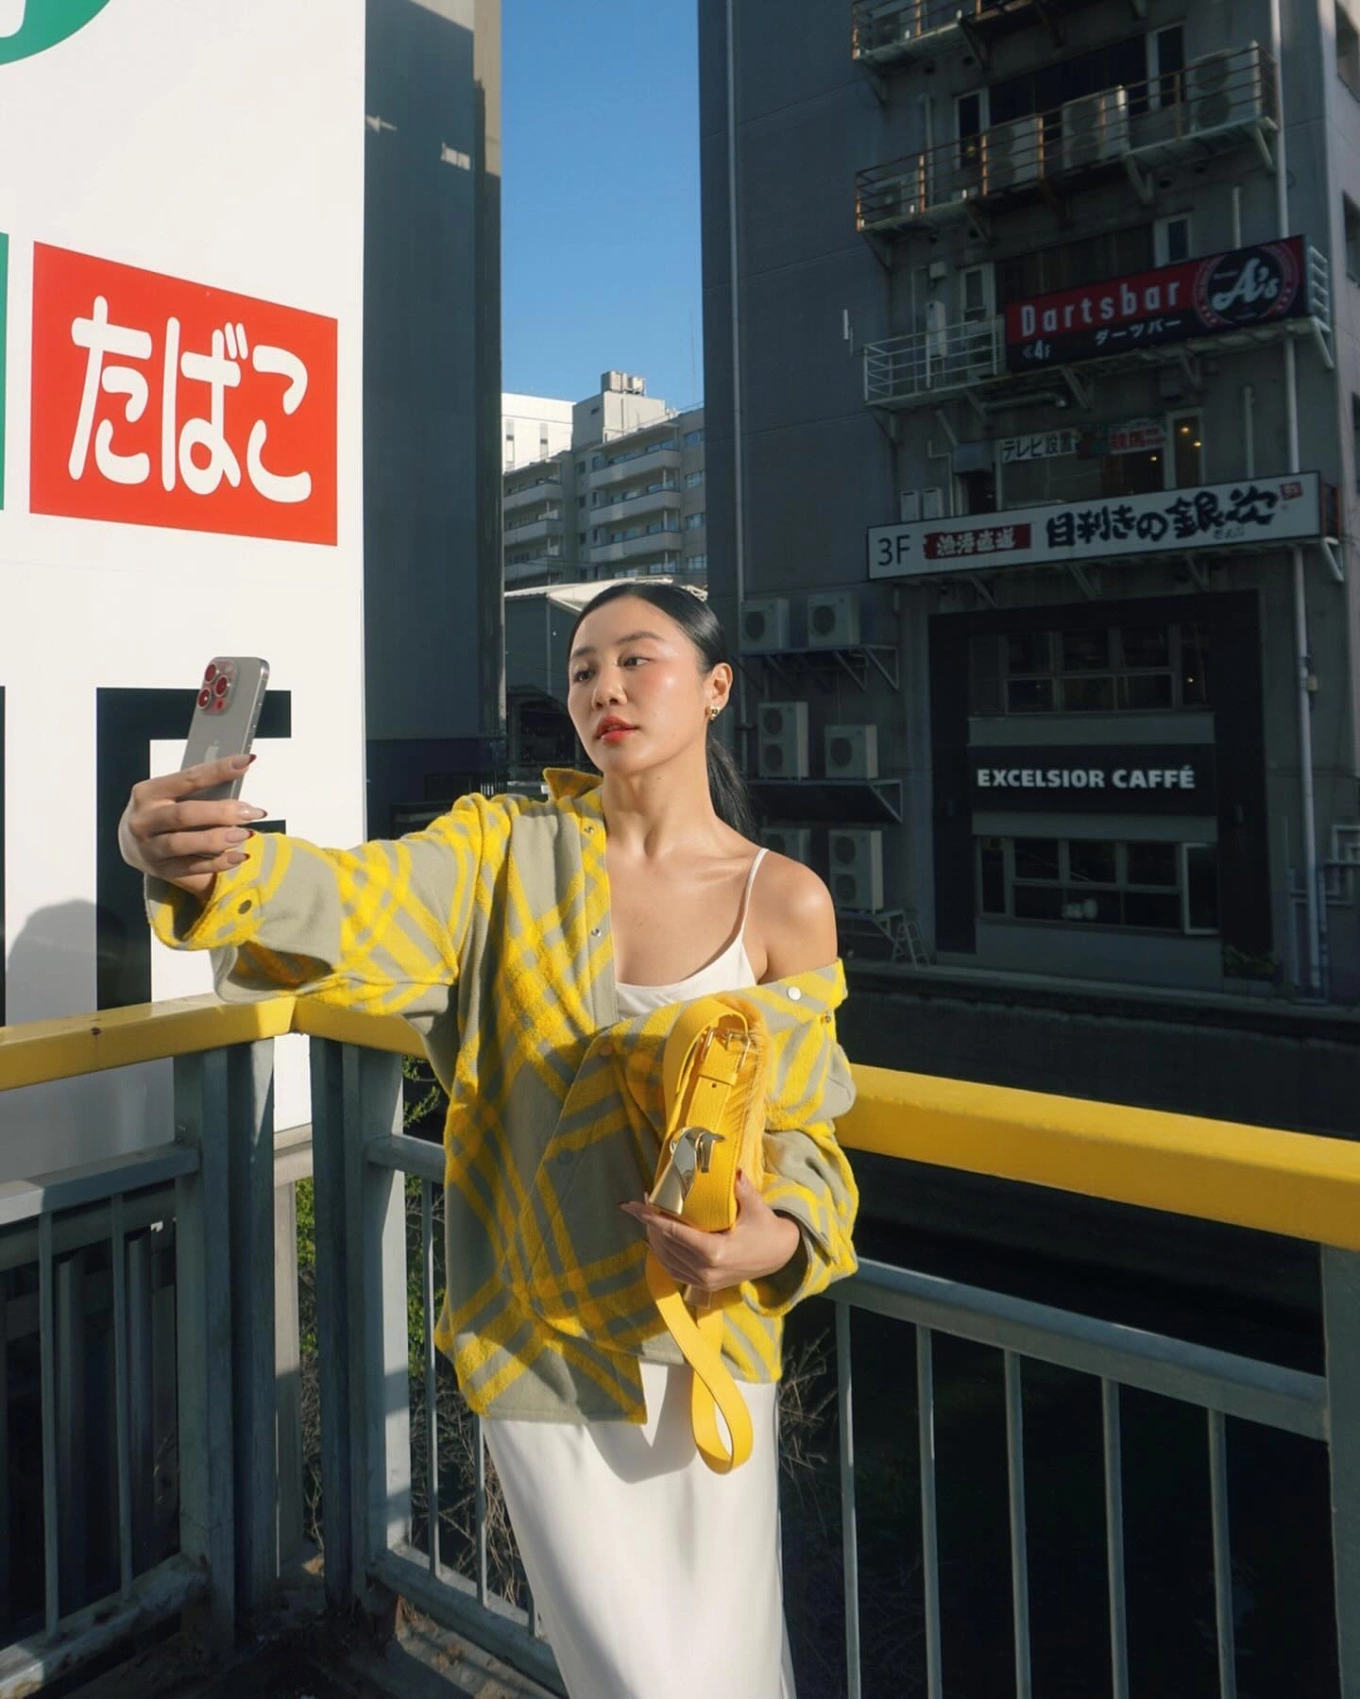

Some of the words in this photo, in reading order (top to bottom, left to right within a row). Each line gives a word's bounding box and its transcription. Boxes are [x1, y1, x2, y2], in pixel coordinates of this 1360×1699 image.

[1020, 281, 1181, 337] Dartsbar
[1094, 317, 1182, 347] ダーツバー
[68, 295, 311, 503] たばこ
[1046, 485, 1278, 547] 目利きの銀次
[878, 535, 911, 566] 3F
[976, 768, 1106, 788] EXCELSIOR
[1111, 765, 1196, 789] CAFFÉ
